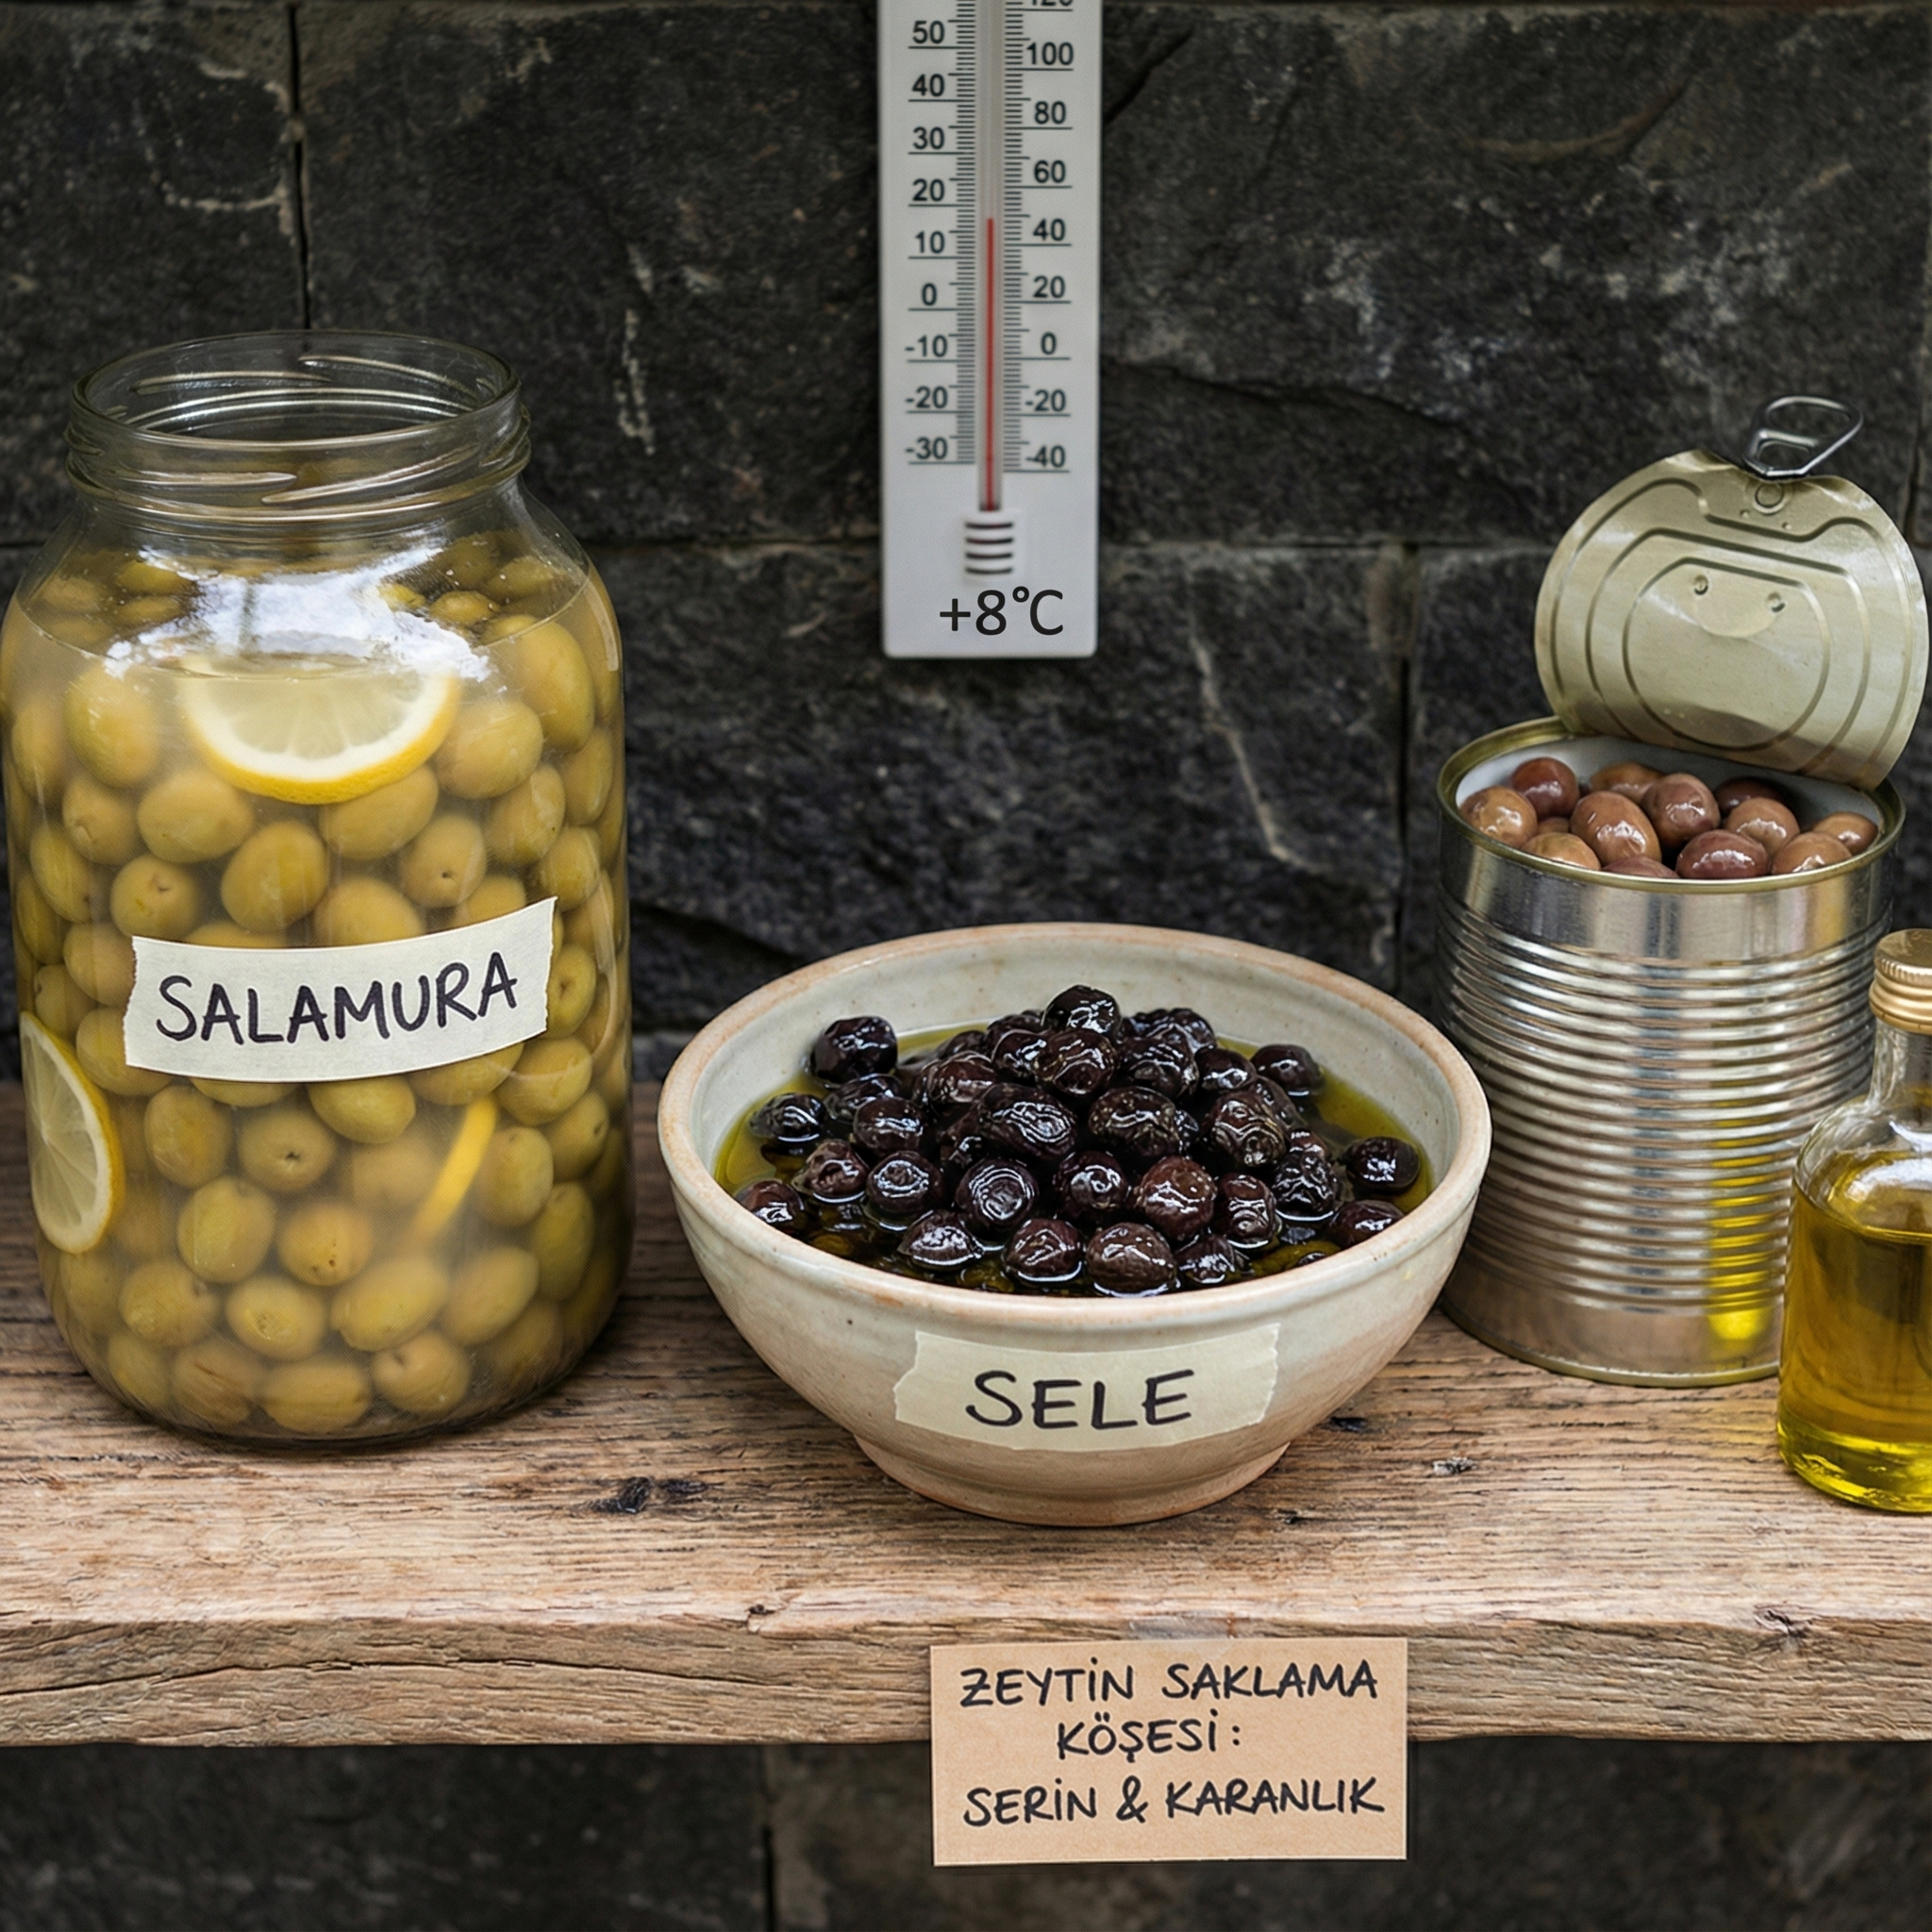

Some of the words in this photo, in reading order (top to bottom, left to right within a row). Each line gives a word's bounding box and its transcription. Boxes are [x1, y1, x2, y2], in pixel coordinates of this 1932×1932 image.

[912, 21, 945, 44] 50
[1027, 42, 1074, 66] 100
[912, 74, 945, 97] 40
[1034, 101, 1066, 125] 80
[912, 126, 945, 150] 30
[1034, 160, 1066, 183] 60
[912, 178, 945, 202] 20
[1033, 218, 1065, 242] 40
[916, 231, 945, 254] 10
[922, 283, 938, 307] 0
[1033, 275, 1065, 298] 20
[905, 335, 948, 358] -10
[1041, 332, 1057, 355] 0
[906, 386, 948, 408] -20
[1025, 389, 1066, 412] -20
[905, 437, 948, 460] -30
[1025, 445, 1066, 468] -40
[940, 586, 1063, 636] +8°C
[157, 952, 517, 1044] SALAMURA
[965, 1369, 1194, 1430] SELE
[960, 1657, 1133, 1707] ZEYTİN
[1161, 1659, 1377, 1699] SAKLAMA
[963, 1777, 1096, 1826] SERİN
[1116, 1774, 1149, 1824] &
[1165, 1776, 1386, 1818] KARANLIK
